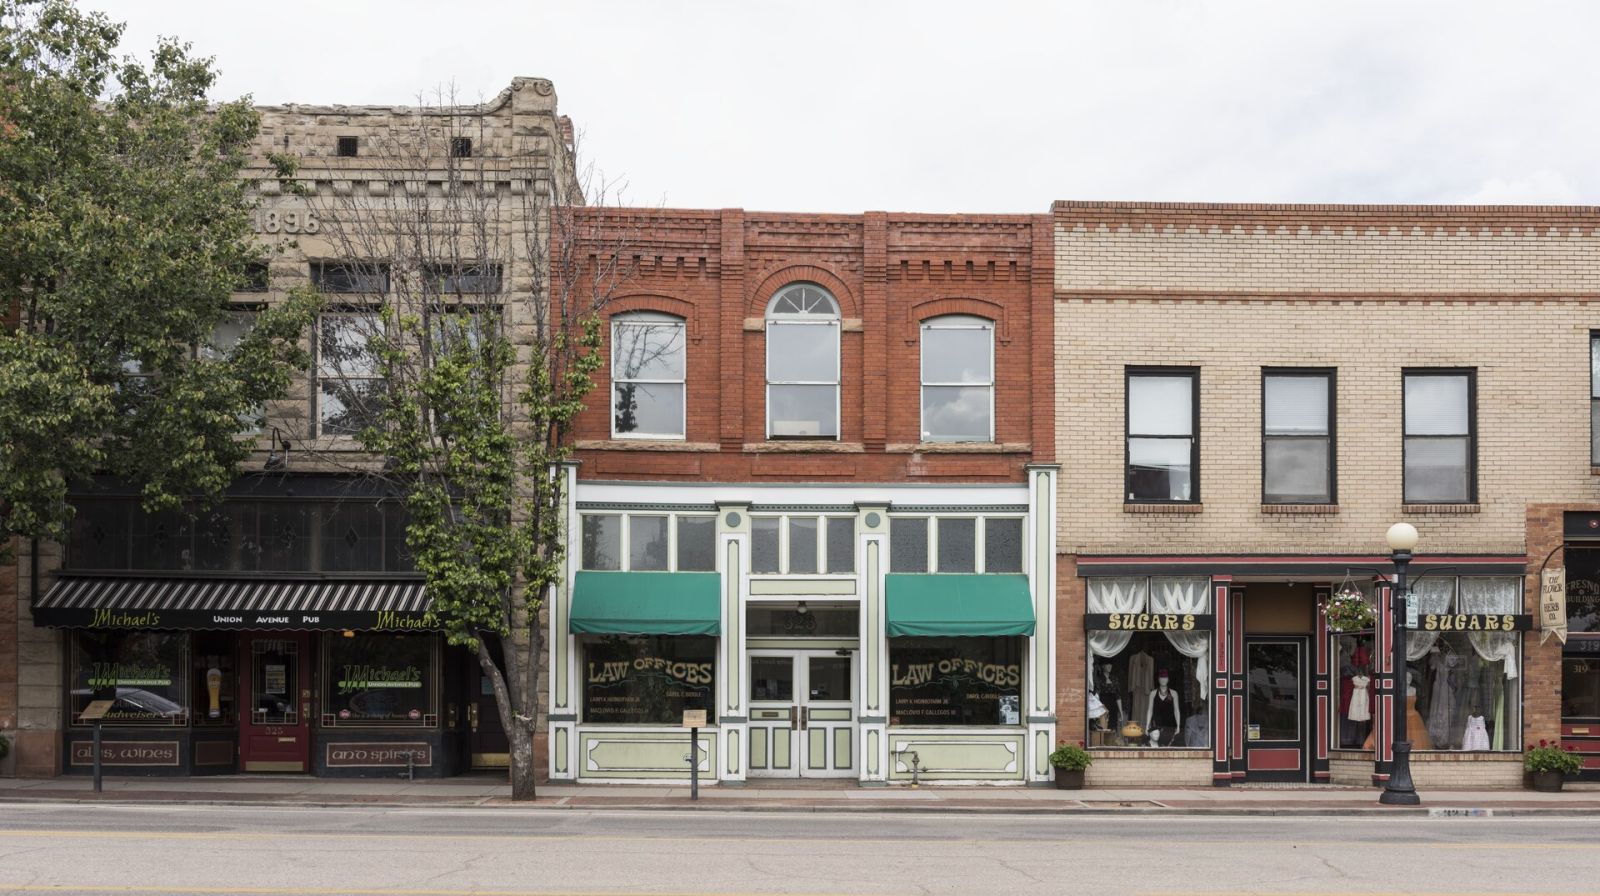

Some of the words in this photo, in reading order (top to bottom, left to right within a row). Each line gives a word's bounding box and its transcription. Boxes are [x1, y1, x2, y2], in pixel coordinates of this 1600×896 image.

[254, 209, 320, 234] 1896
[1109, 613, 1195, 630] SUGARS
[1425, 614, 1515, 631] SUGARS
[589, 662, 629, 683] LAW
[634, 657, 713, 684] OFFICES
[892, 663, 934, 686] LAW
[938, 658, 1020, 687] OFFICES
[265, 726, 284, 736] 325
[77, 746, 116, 759] als,
[120, 749, 173, 759] wines
[370, 749, 426, 762] spirts
